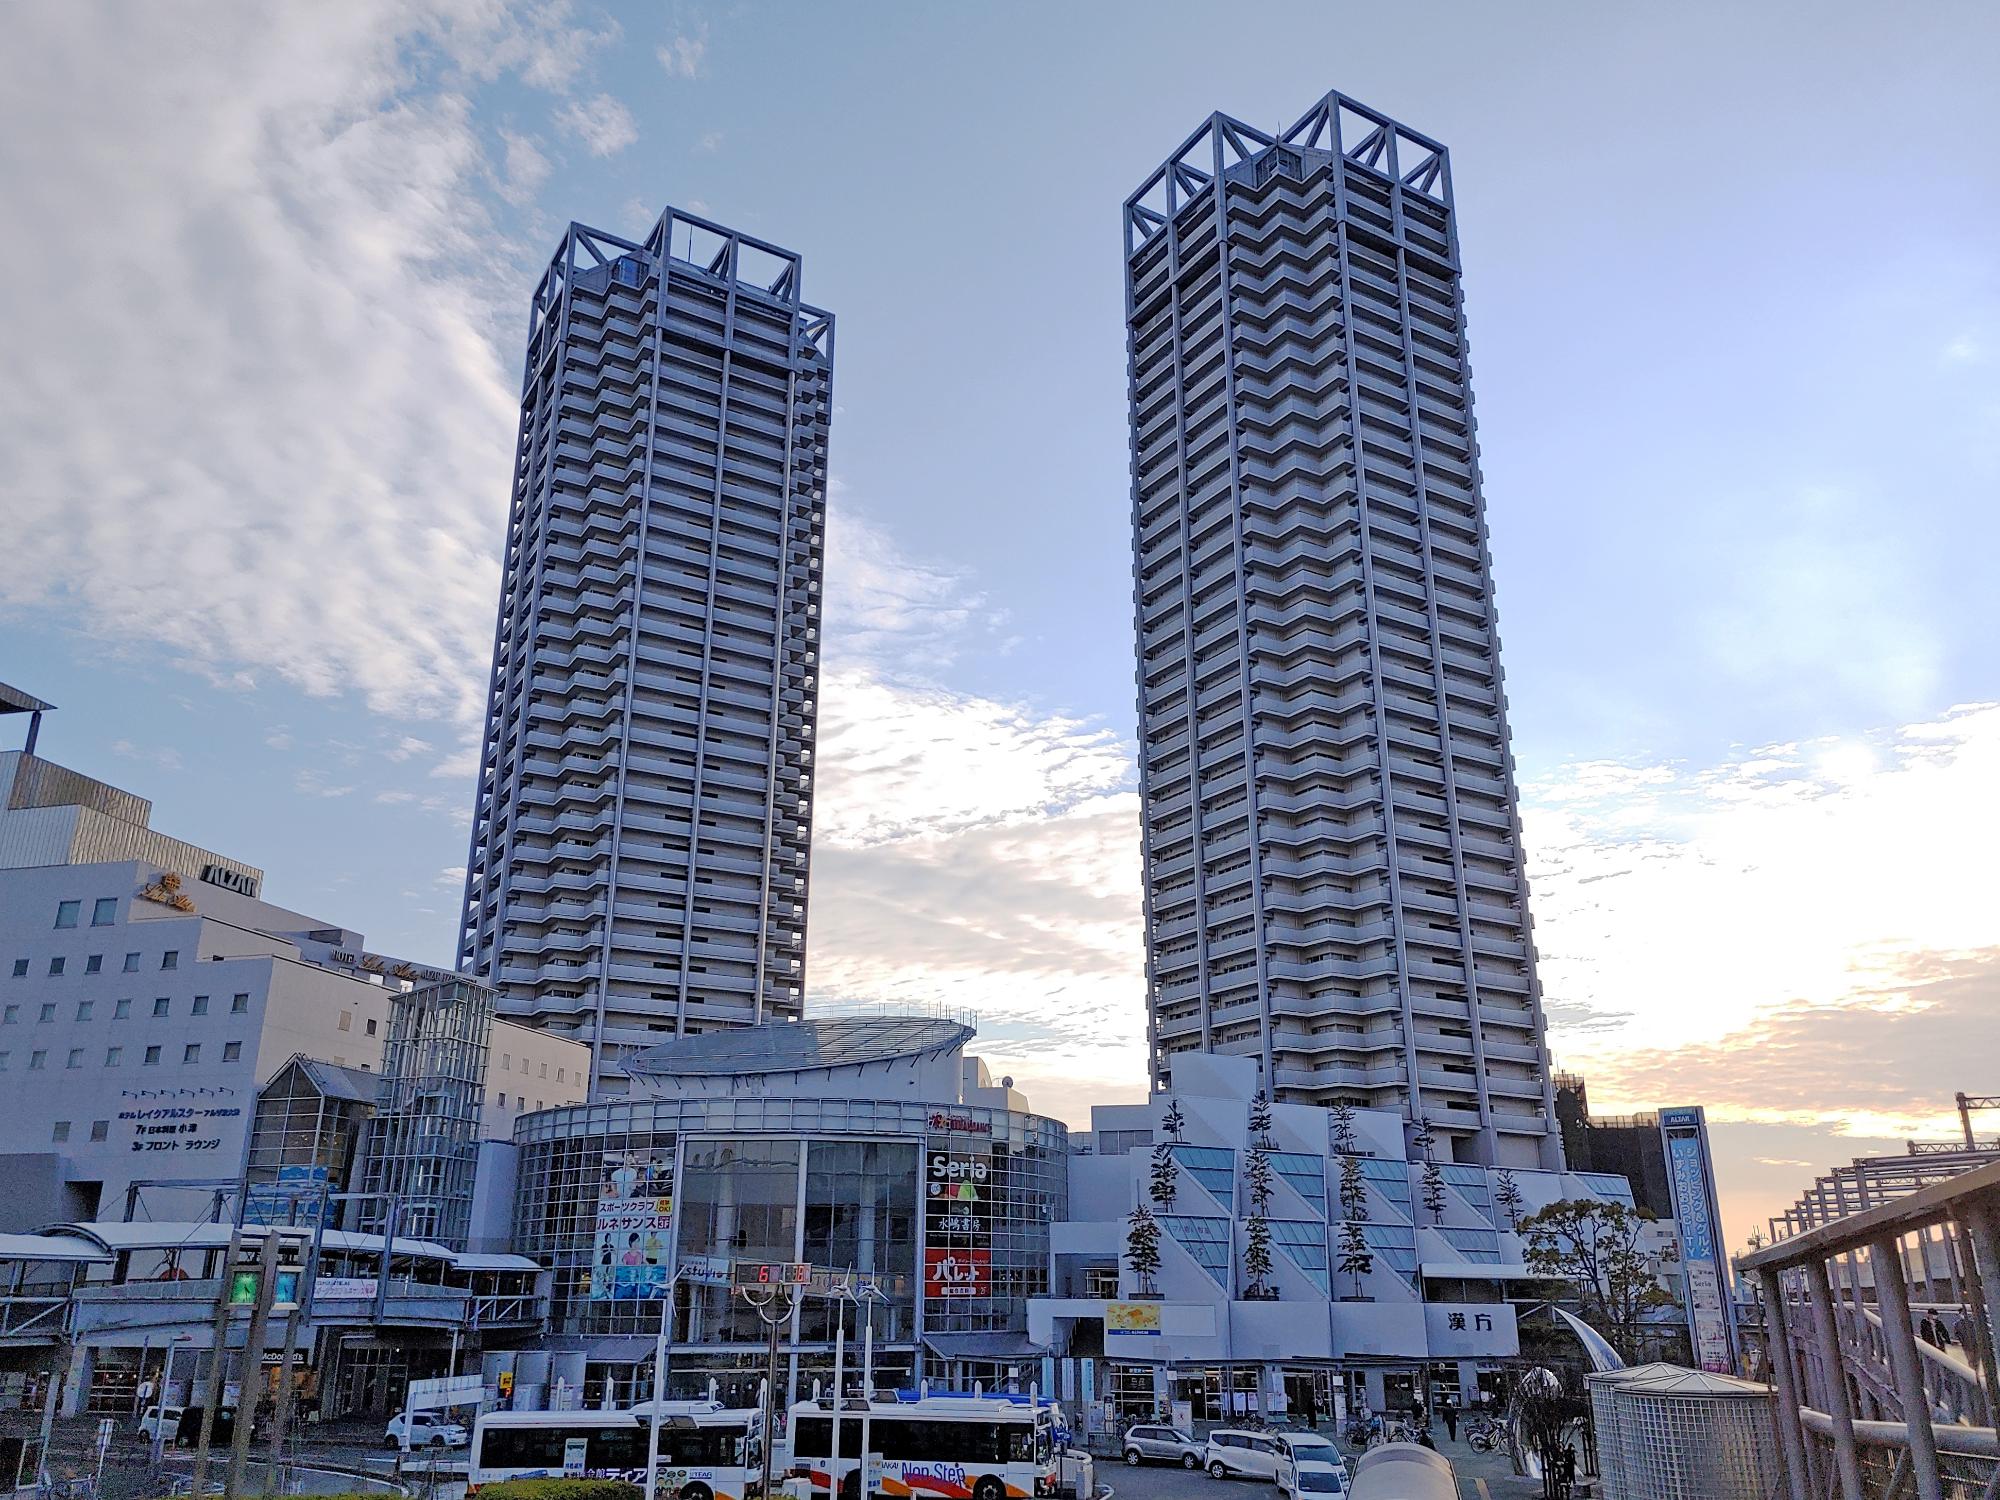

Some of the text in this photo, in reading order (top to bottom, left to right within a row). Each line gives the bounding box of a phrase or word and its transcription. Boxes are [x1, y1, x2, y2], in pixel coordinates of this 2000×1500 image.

[145, 1140, 179, 1151] フロント
[185, 1139, 221, 1151] ラウンジ
[933, 1155, 987, 1179] Seria
[600, 1201, 656, 1212] スポーツクラブ
[597, 1217, 656, 1230] ルネサンス
[933, 1256, 980, 1281] パレット
[1448, 1312, 1492, 1331] 漢方
